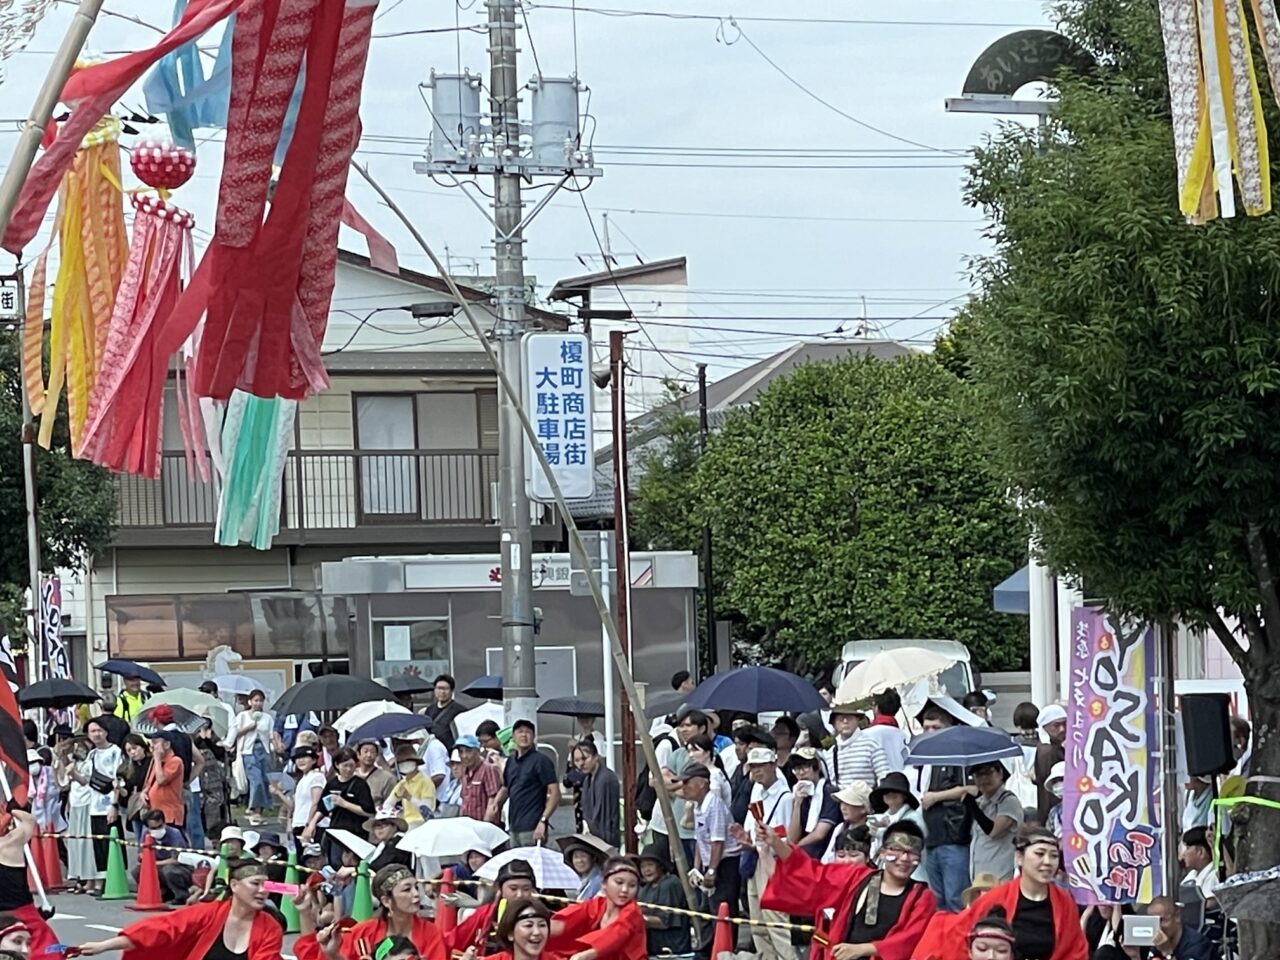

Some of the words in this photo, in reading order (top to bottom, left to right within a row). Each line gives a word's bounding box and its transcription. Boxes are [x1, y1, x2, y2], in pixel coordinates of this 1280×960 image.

[535, 366, 561, 466] 大駐車場
[560, 340, 587, 466] 榎町商店街
